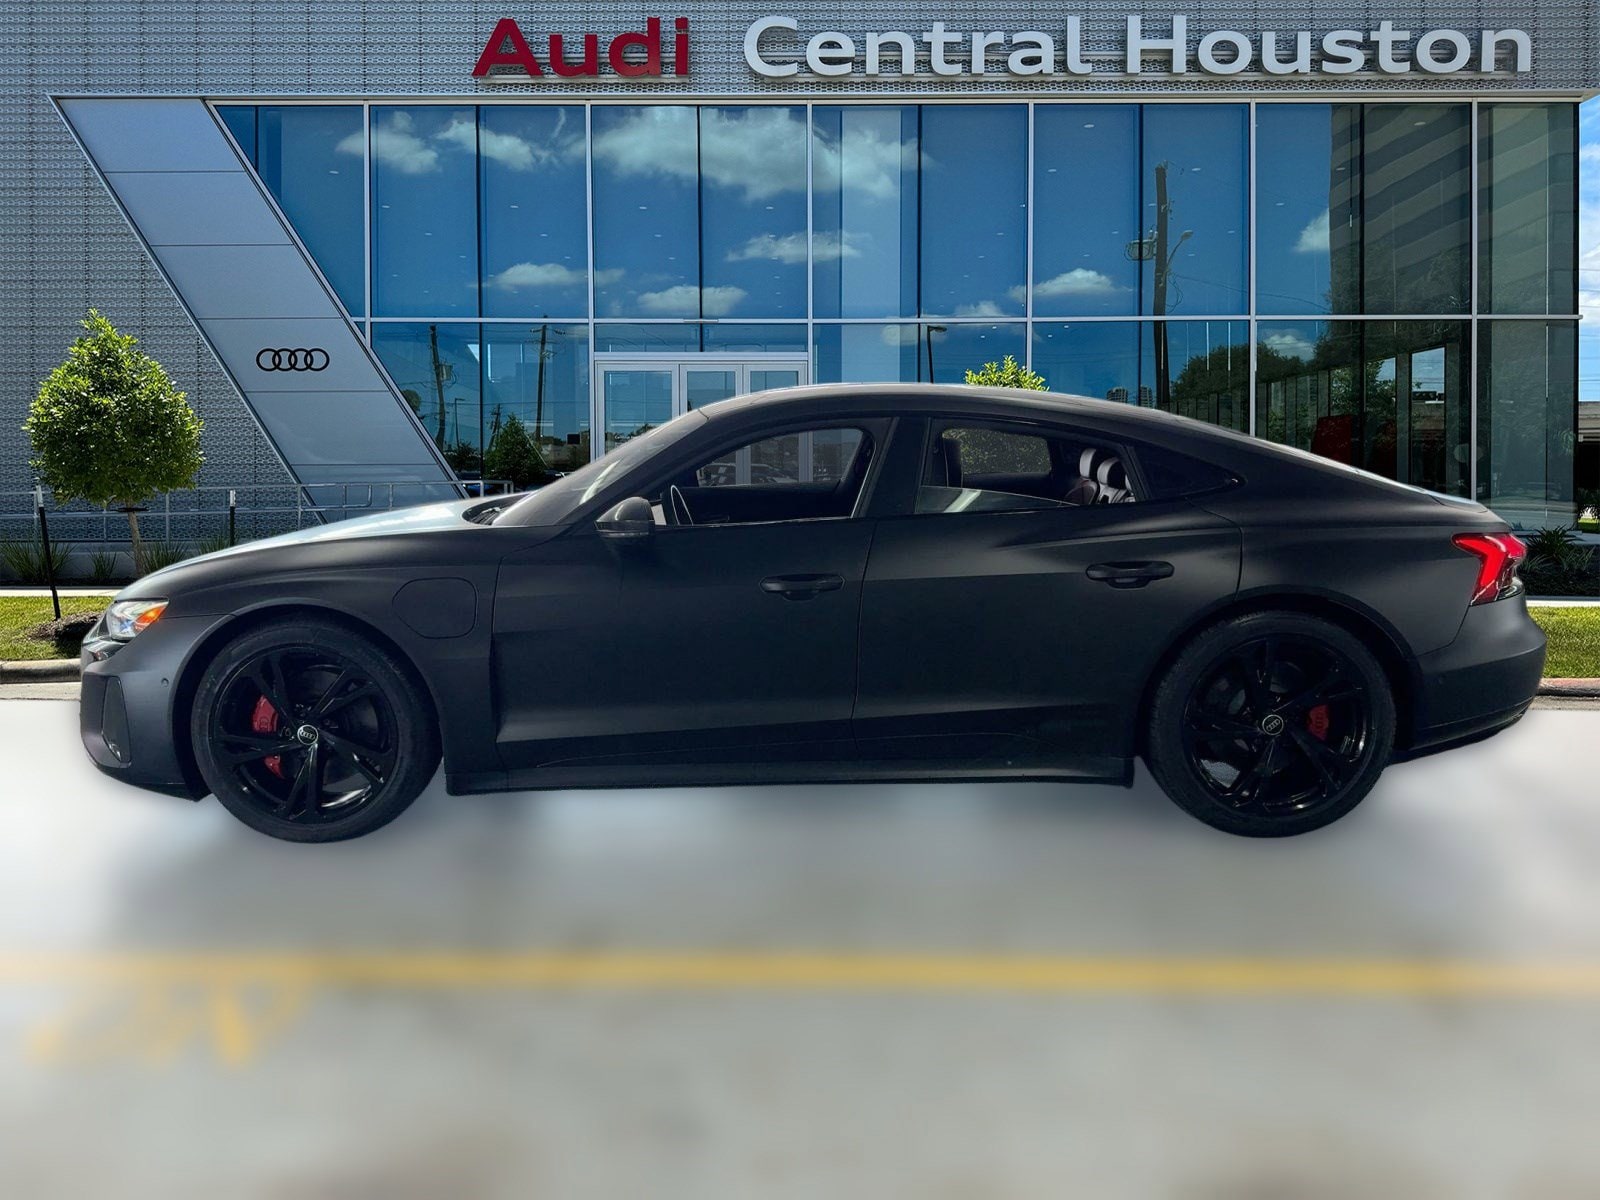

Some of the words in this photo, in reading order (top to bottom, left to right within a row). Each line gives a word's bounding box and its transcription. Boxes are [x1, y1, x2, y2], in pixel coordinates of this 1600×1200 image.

[472, 16, 690, 78] Audi
[743, 16, 1092, 77] Central
[1126, 15, 1532, 75] Houston
